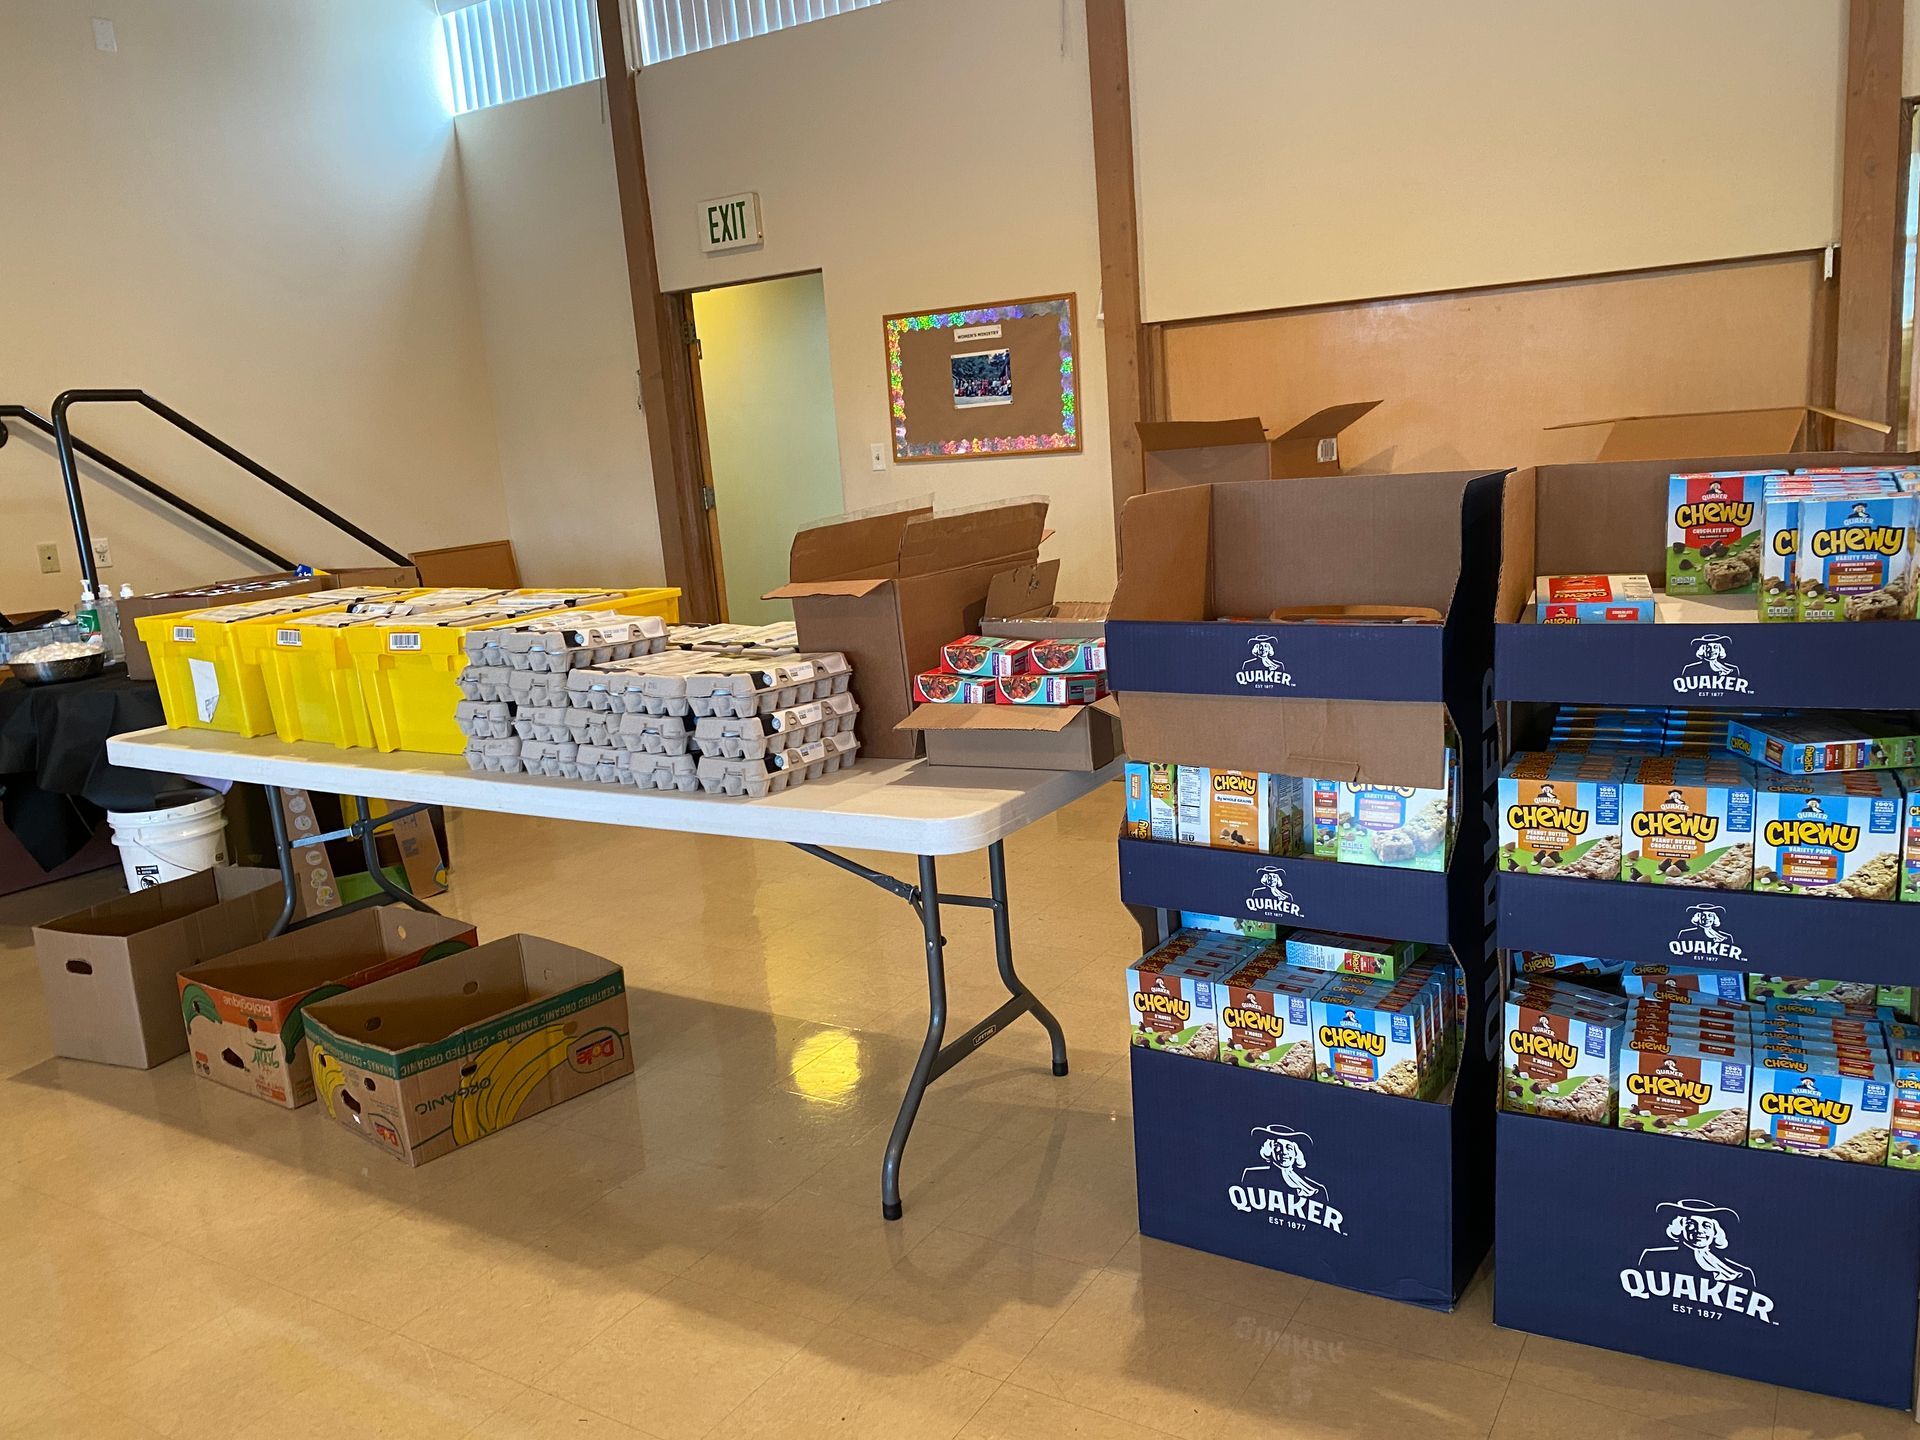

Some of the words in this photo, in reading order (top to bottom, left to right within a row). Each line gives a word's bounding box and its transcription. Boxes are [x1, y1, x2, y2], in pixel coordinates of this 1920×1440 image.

[707, 201, 747, 244] EXIT
[1701, 493, 1728, 501] QUAKER
[1675, 502, 1754, 528] CHEWY
[1843, 518, 1874, 526] QUAKER
[1722, 526, 1736, 534] CHIP
[1812, 526, 1905, 557] CHEWY
[1235, 670, 1292, 687] QUAKER
[1672, 674, 1749, 694] QUAKER
[1804, 745, 1816, 772] CHEWY
[1212, 774, 1257, 796] CHEWY
[1534, 797, 1561, 806] QUAKER
[1507, 804, 1589, 835] CHEWY
[1797, 812, 1828, 820] QUAKER
[1631, 811, 1720, 843] CHEWY
[1764, 820, 1861, 853] CHEWY
[1245, 897, 1300, 918] QUAKER
[1669, 940, 1742, 961] QUAKER
[1523, 956, 1556, 974] CHEWY
[1632, 965, 1670, 976] CHEWY
[578, 986, 616, 1009] CERTIFIED
[1151, 987, 1171, 996] QUAKER
[1654, 991, 1692, 1005] CHEWY
[222, 995, 272, 1017] biologique
[540, 1002, 577, 1022] ORGANIC
[1134, 991, 1190, 1020] CHEWY
[1241, 1002, 1262, 1011] QUAKER
[1776, 1004, 1816, 1015] CHEWY
[496, 1016, 539, 1040] BANANAS
[1154, 1014, 1172, 1022] S'MORES
[1223, 1006, 1284, 1038] CHEWY
[1340, 1021, 1362, 1029] QUAKER
[1245, 1030, 1263, 1038] S'MORES
[1319, 1025, 1386, 1057] CHEWY
[1532, 1026, 1556, 1038] QUAKER
[576, 1040, 615, 1066] Dole
[1509, 1030, 1578, 1070] CHEWY
[1630, 1040, 1672, 1054] CHEWY
[400, 1054, 444, 1076] ORGANIC
[1532, 1058, 1553, 1068] S'MORES
[1655, 1068, 1684, 1078] QUAKER
[1763, 1058, 1808, 1072] CHEWY
[1627, 1073, 1712, 1105] CHEWY
[1792, 1088, 1822, 1098] QUAKER
[1896, 1079, 1920, 1089] CHEW
[414, 1077, 491, 1116] ORGANIC
[1656, 1097, 1682, 1105] S'MORES
[1760, 1092, 1853, 1125] CHEWY
[1783, 1115, 1808, 1124] VARIETY
[375, 1124, 400, 1148] Dole
[1228, 1185, 1344, 1235] QUAKER
[1268, 1216, 1284, 1226] EST
[1287, 1220, 1307, 1231] 1877
[1619, 1268, 1774, 1325] QUAKER
[1672, 1304, 1693, 1315] EST
[1696, 1309, 1723, 1321] 1877
